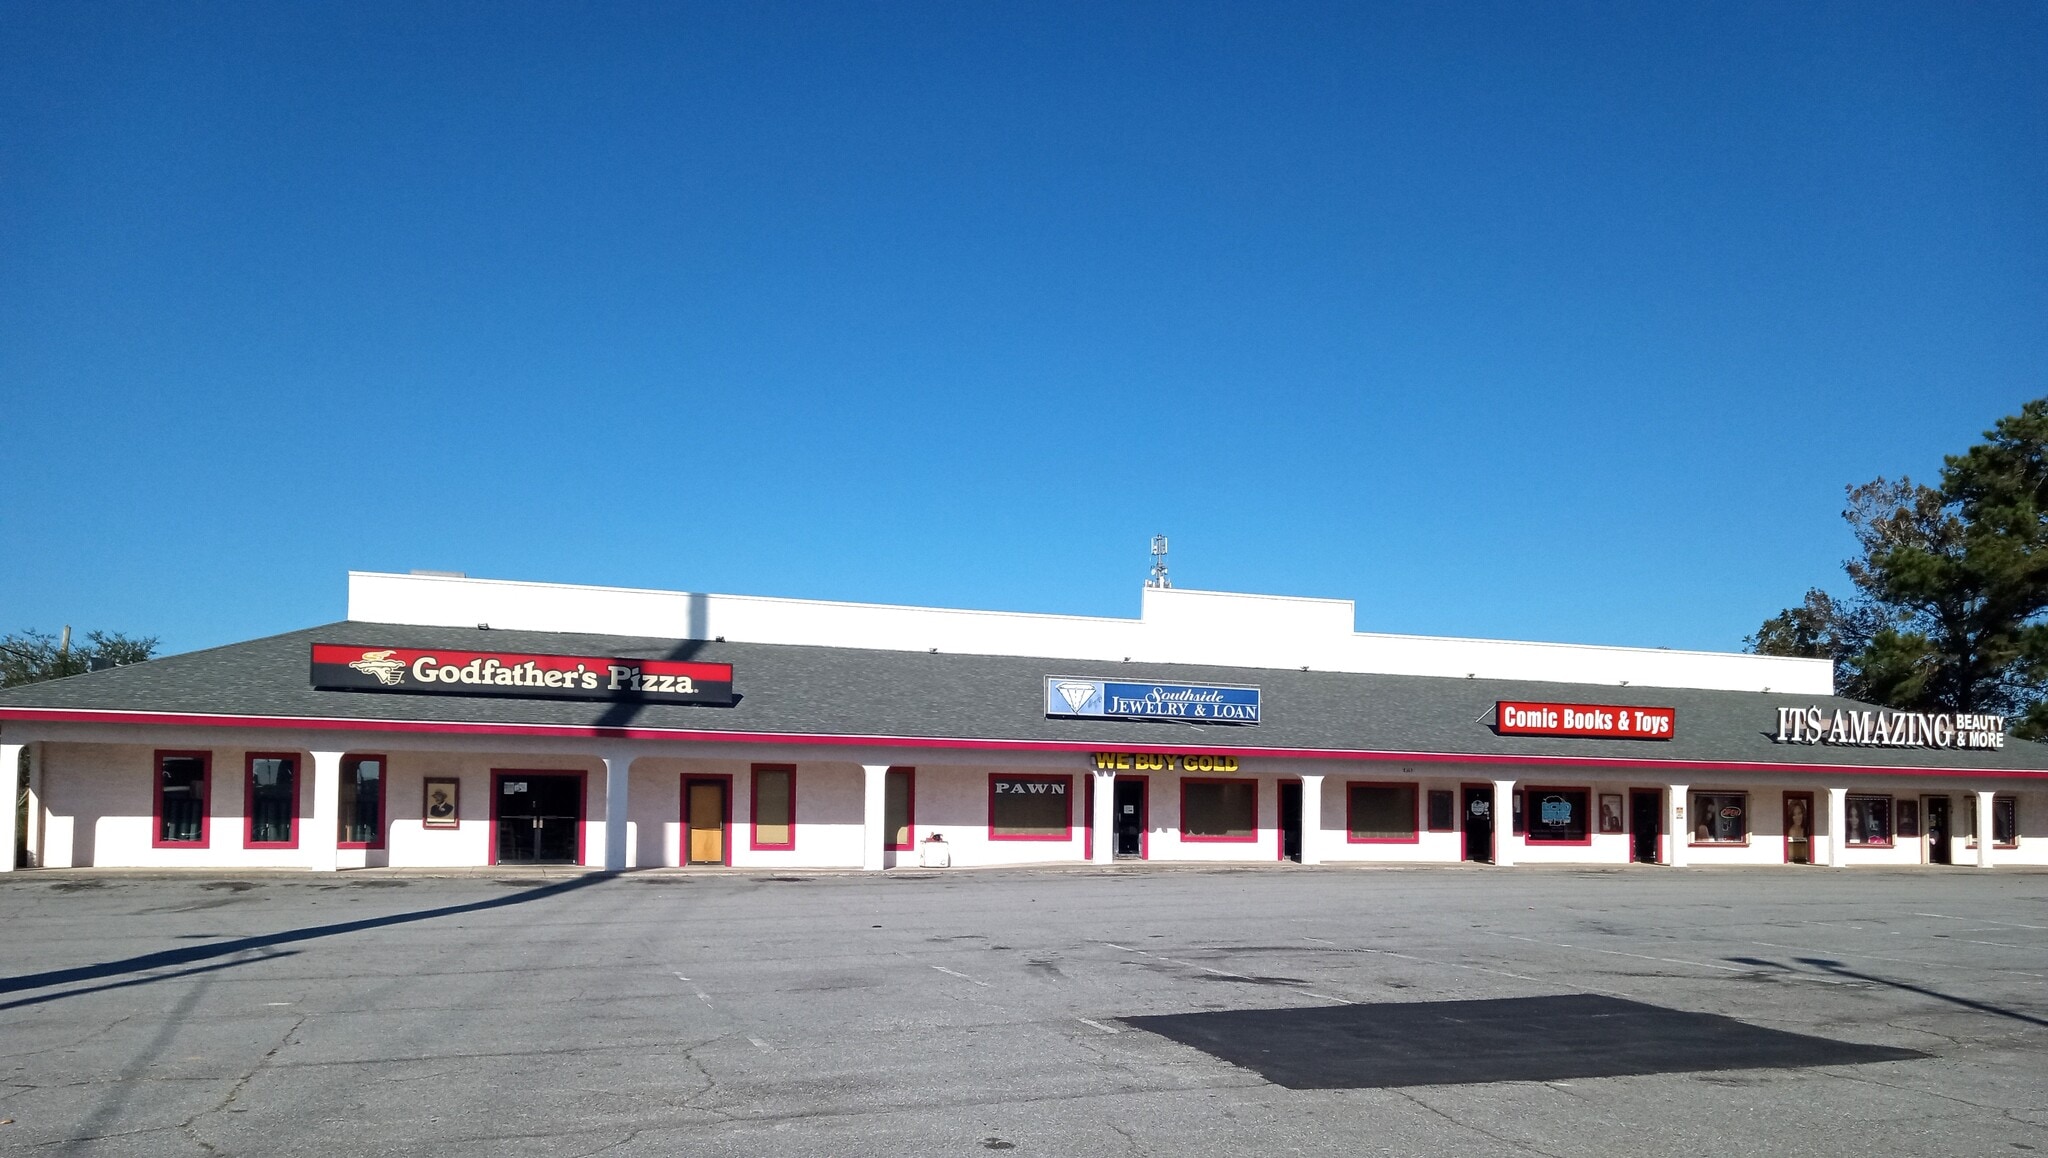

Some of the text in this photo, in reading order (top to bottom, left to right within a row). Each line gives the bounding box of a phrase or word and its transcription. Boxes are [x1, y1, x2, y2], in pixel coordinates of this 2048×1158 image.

[412, 657, 694, 694] Godfather's Pizza
[1145, 687, 1224, 704] Southside
[1108, 696, 1258, 720] JEWELRY & LOAN
[1505, 706, 1669, 735] Comic Books & Toys
[1828, 708, 1952, 747] AMAZING
[1956, 714, 2004, 731] BEAUTY
[1957, 733, 2004, 747] & MORE
[1096, 753, 1239, 773] WE BUY GOLD
[995, 783, 1065, 794] PAWN
